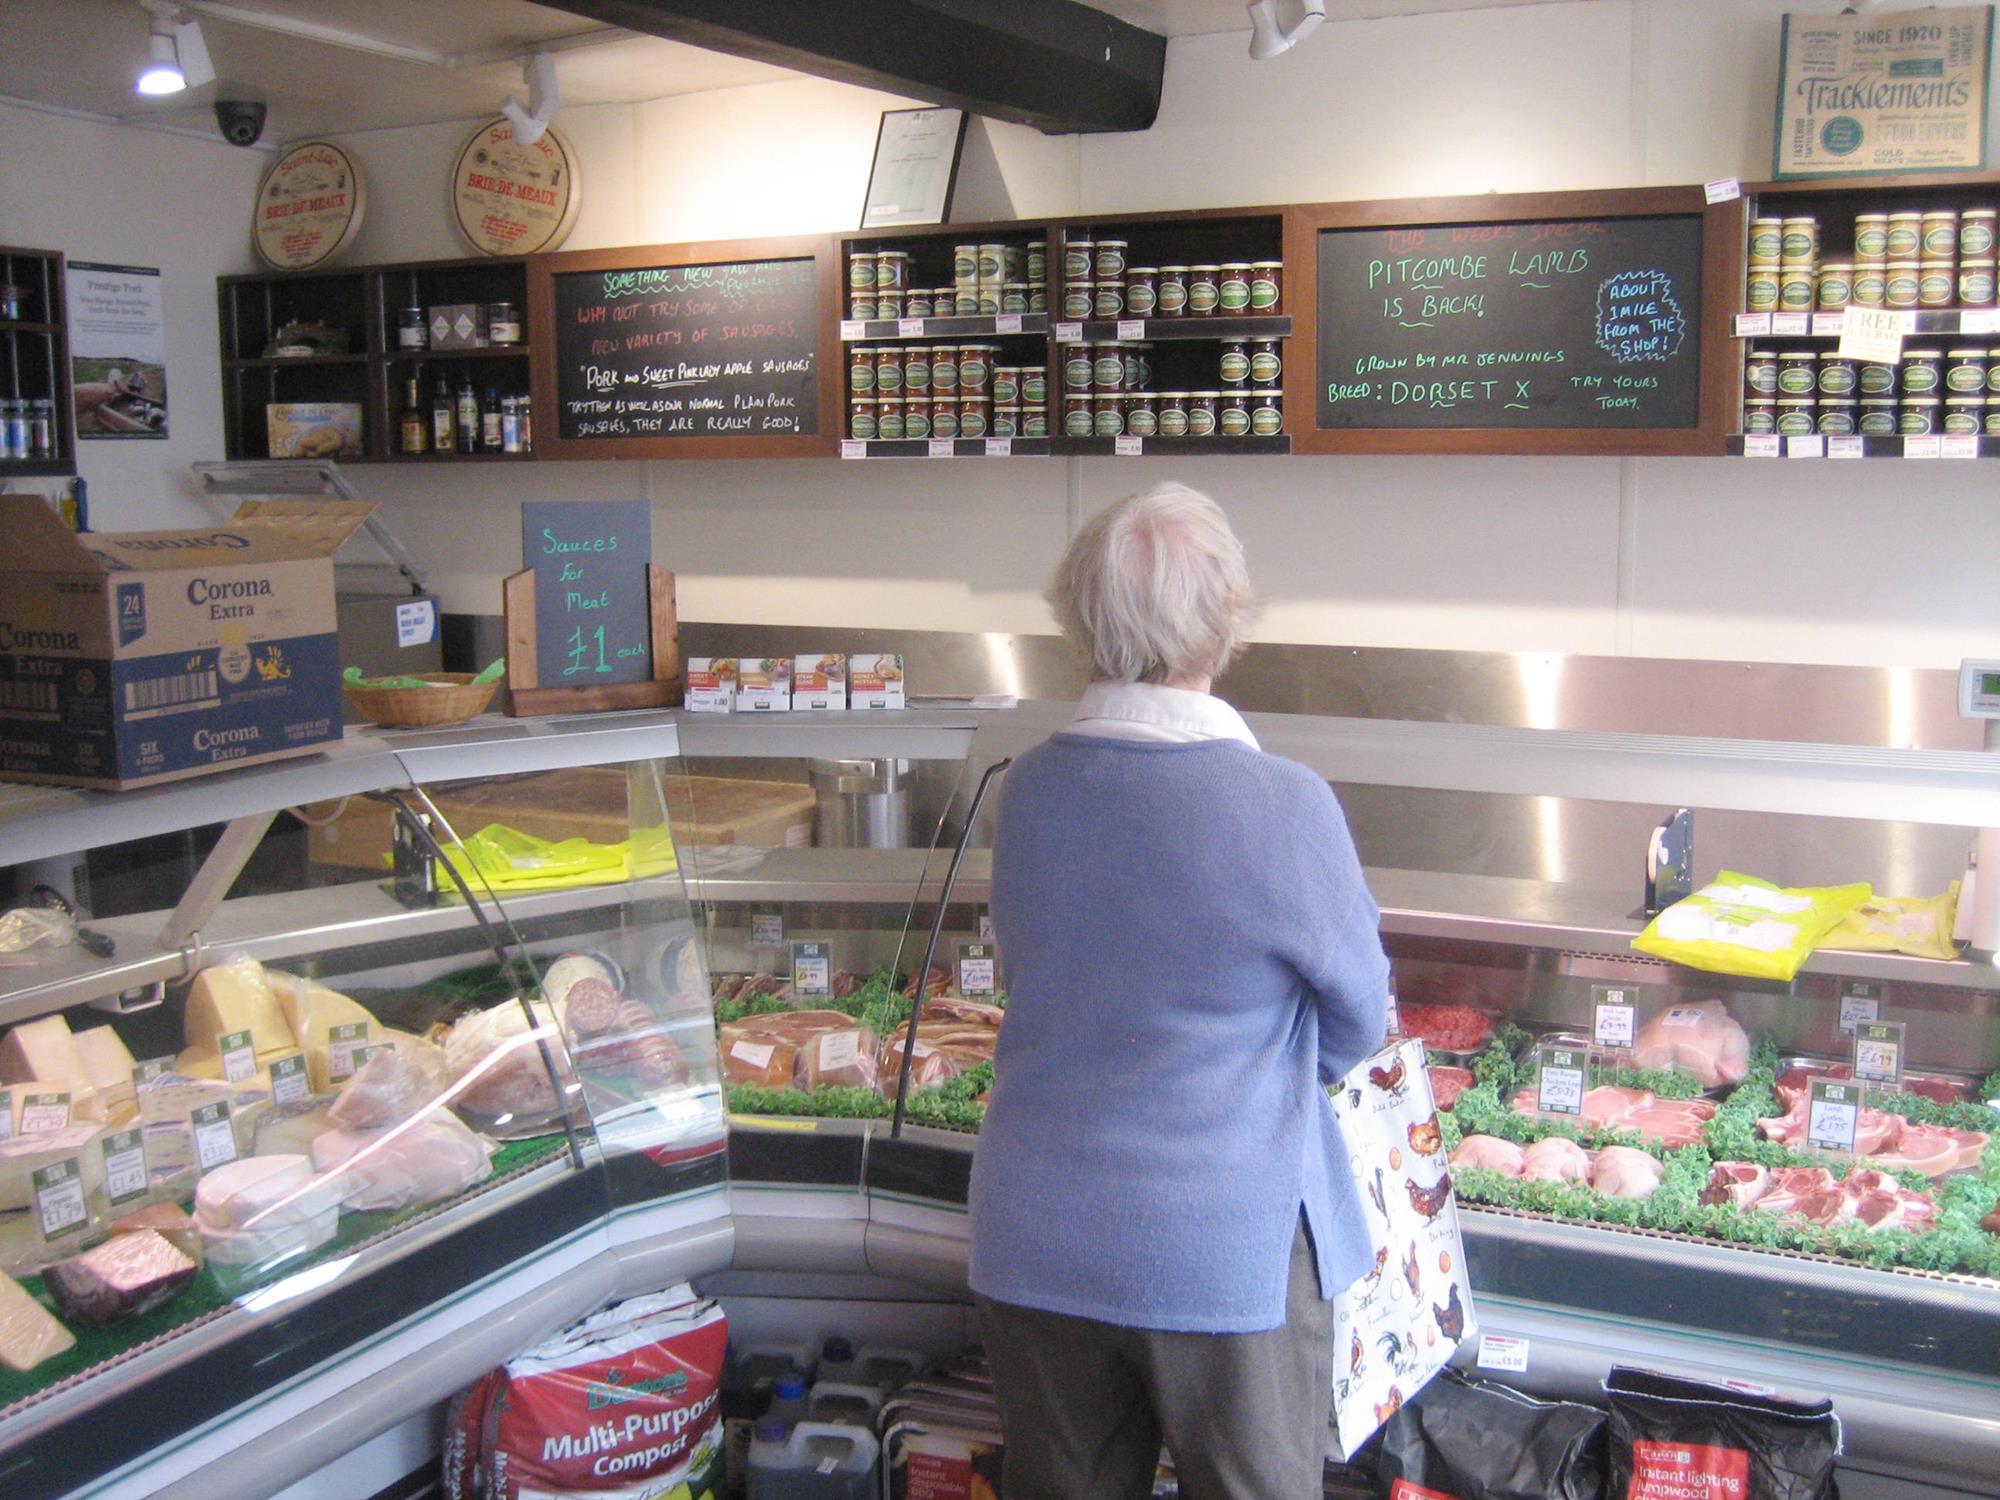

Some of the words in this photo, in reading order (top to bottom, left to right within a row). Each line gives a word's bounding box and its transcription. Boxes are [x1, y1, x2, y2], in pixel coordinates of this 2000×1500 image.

[1853, 29, 1892, 45] SINCE
[1899, 25, 1942, 42] 1970
[1797, 72, 1970, 114] Tracklements
[467, 173, 496, 192] BRIE
[497, 180, 514, 196] DE
[515, 184, 561, 207] MEAUX
[265, 204, 289, 220] BRIE
[309, 193, 346, 211] MEAUX
[603, 269, 671, 292] SOMETHING
[684, 267, 713, 282] NEW
[1368, 255, 1488, 289] PITCOMBE
[1508, 249, 1589, 275] LAMB
[1609, 280, 1660, 299] ABOUT
[577, 306, 607, 324] WHY
[612, 303, 639, 321] NOT
[649, 302, 679, 318] TRY
[685, 299, 717, 316] SOME
[1382, 298, 1403, 318] IS
[1422, 295, 1486, 319] BACK!
[1604, 322, 1641, 341] FROM
[1648, 317, 1676, 333] THE
[592, 339, 618, 356] NEW
[626, 330, 682, 351] VARIETY
[692, 327, 709, 343] OF
[1619, 336, 1669, 355] SHOP!
[641, 366, 674, 385] SWEET
[724, 361, 753, 376] APPLE
[1356, 355, 1409, 375] GROWN
[1416, 353, 1437, 369] BY
[1442, 353, 1470, 367] MR
[1477, 350, 1566, 367] JENNINGS
[1391, 380, 1499, 403] DORSET
[1514, 380, 1532, 399] X
[1570, 376, 1603, 389] TRY
[1613, 377, 1658, 389] YOURS
[689, 398, 725, 411] NORMAL
[734, 393, 765, 409] PLAIN
[766, 393, 796, 408] PORK
[632, 417, 662, 432] THEY
[669, 416, 695, 430] ARE
[707, 416, 752, 431] REALLY
[762, 416, 800, 432] GOOD!
[112, 534, 250, 551] Corona
[543, 528, 618, 554] Sauces
[187, 578, 271, 605] Corona
[566, 591, 609, 612] Meat
[124, 595, 140, 615] 24
[209, 604, 255, 621] Extra
[0, 622, 81, 650] Corona
[562, 624, 613, 676] £1
[617, 642, 645, 658] each
[15, 656, 65, 676] Extra
[193, 726, 261, 752] Corona
[212, 746, 248, 761] Extra
[593, 1433, 688, 1477] Compost
[1637, 1481, 1709, 1500] lumpwood
[1640, 1466, 1686, 1483] Instant
[1687, 1470, 1739, 1492] lighting
